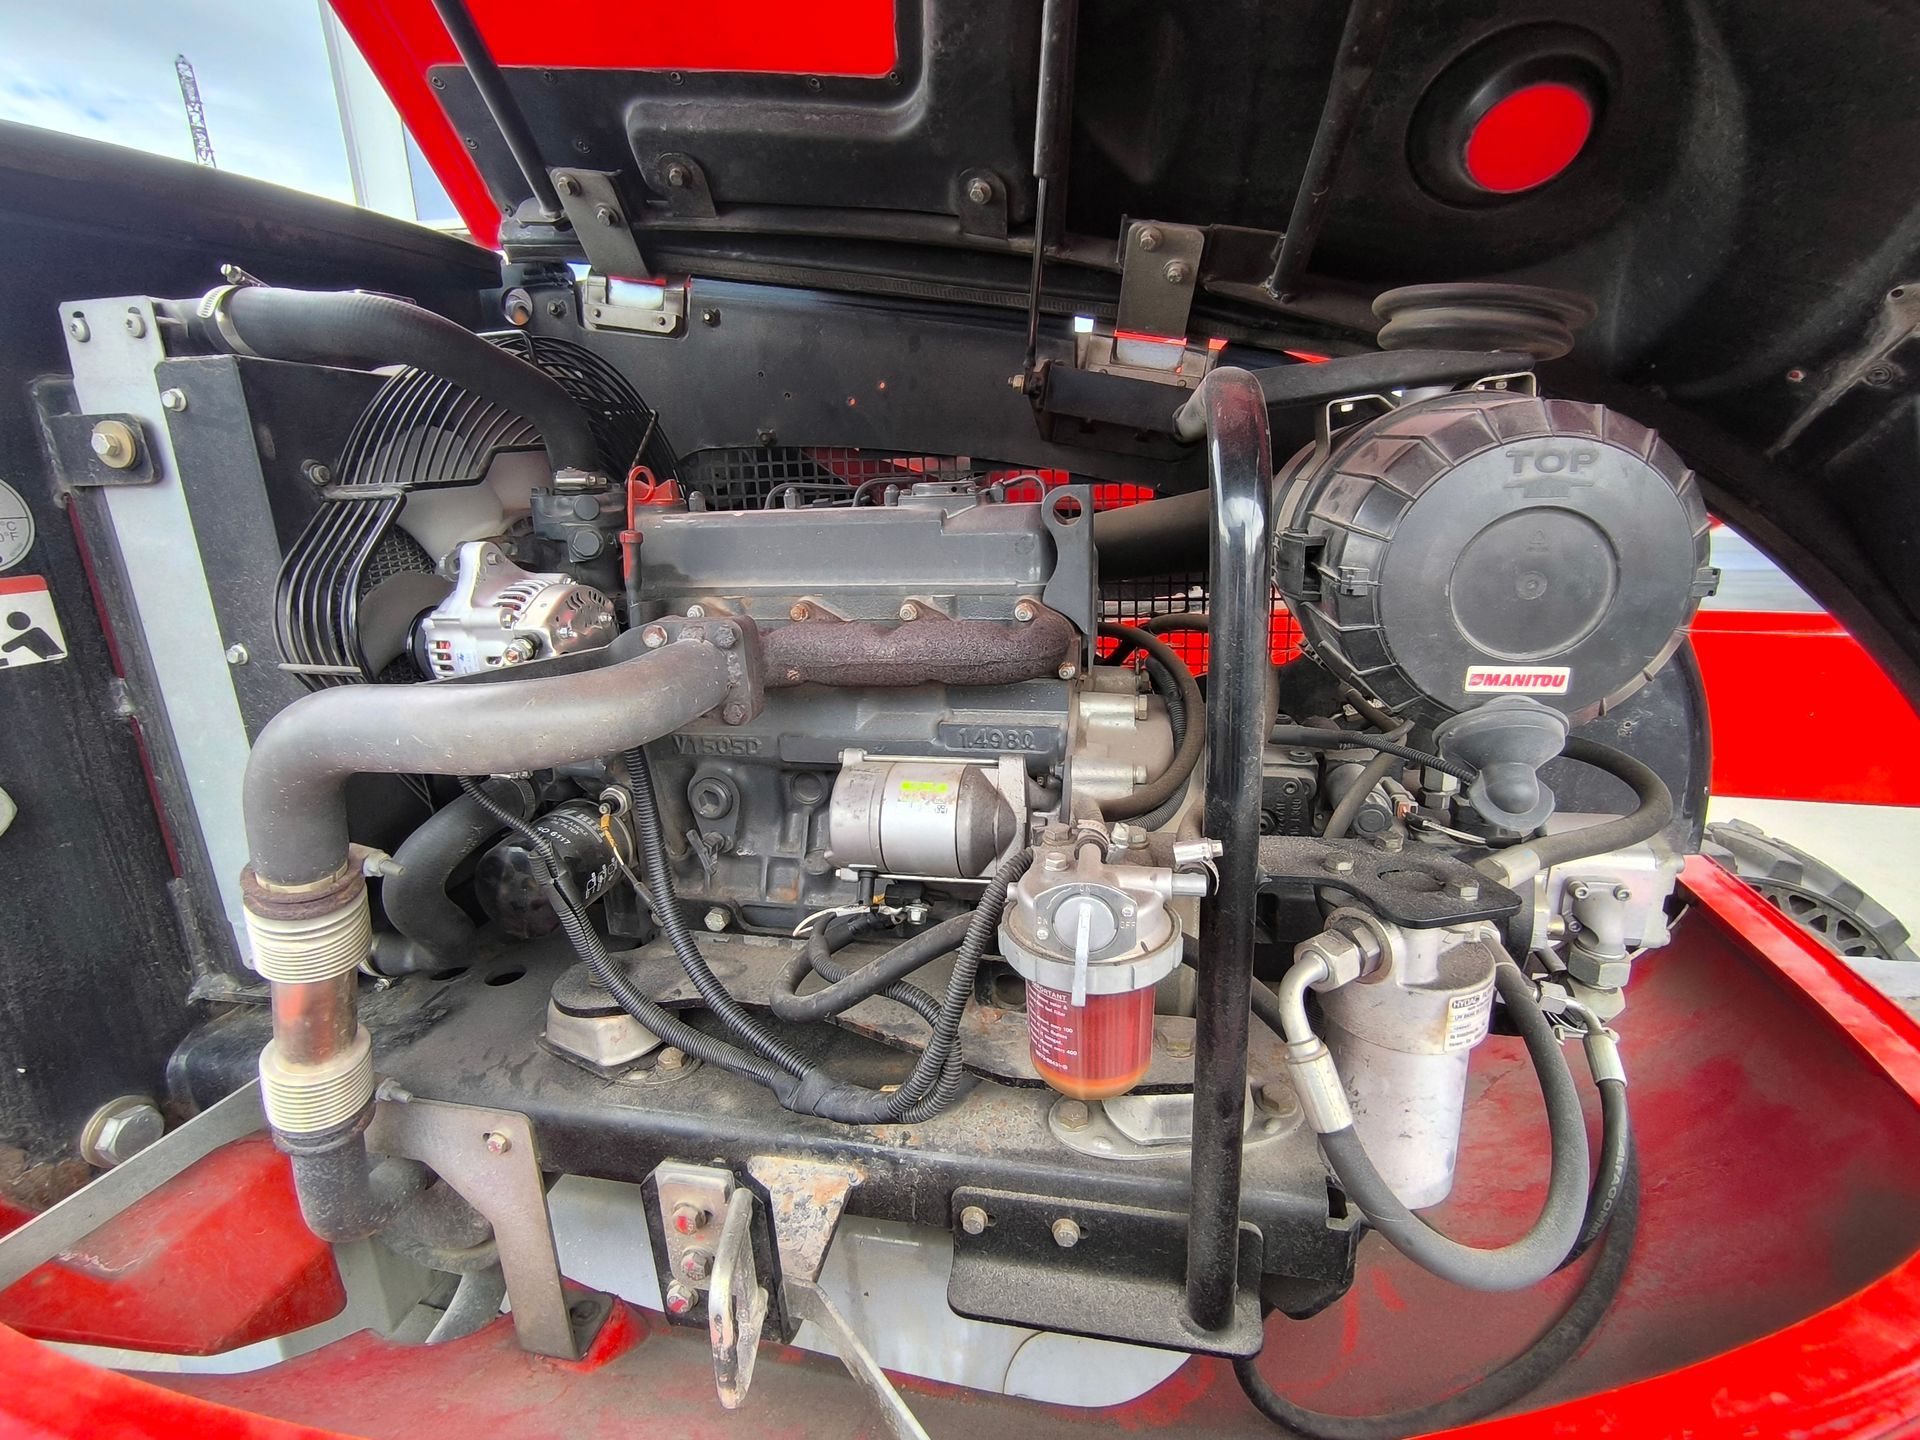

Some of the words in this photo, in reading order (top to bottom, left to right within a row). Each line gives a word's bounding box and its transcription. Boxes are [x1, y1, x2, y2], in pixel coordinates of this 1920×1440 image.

[1505, 447, 1599, 473] TOP
[1483, 674, 1566, 687] MANITOU
[1119, 920, 1136, 929] OFF
[1063, 1026, 1073, 1034] 100
